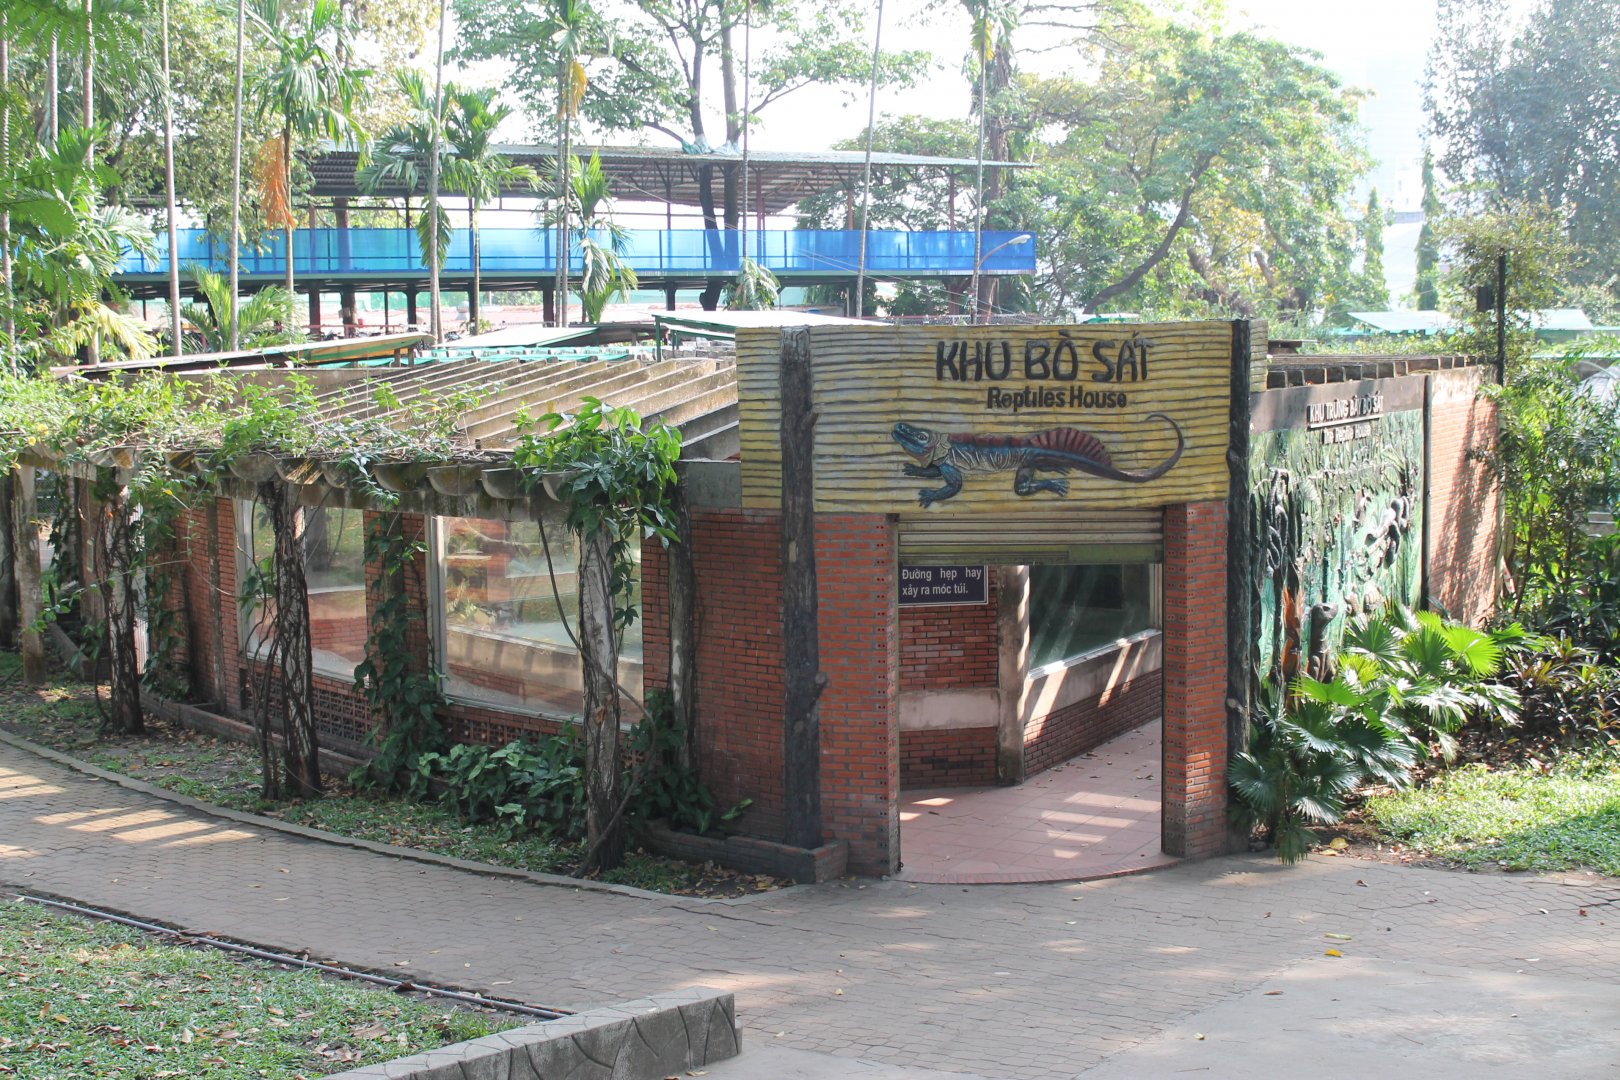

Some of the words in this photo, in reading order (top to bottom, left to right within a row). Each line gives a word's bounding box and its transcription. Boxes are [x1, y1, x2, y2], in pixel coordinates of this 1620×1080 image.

[936, 340, 1011, 382] KHU
[1024, 329, 1079, 381] BÒ
[1091, 330, 1155, 383] SÁT
[987, 385, 1066, 412] Reptiles
[1070, 385, 1128, 409] House
[1309, 403, 1325, 423] KHU
[1373, 390, 1384, 413] SÁT
[902, 568, 932, 582] Đường
[940, 567, 957, 581] hẹp
[965, 566, 982, 580] hay
[902, 583, 918, 598] xảy
[921, 586, 930, 595] ra
[932, 583, 952, 594] móc
[954, 583, 969, 594] túi.
